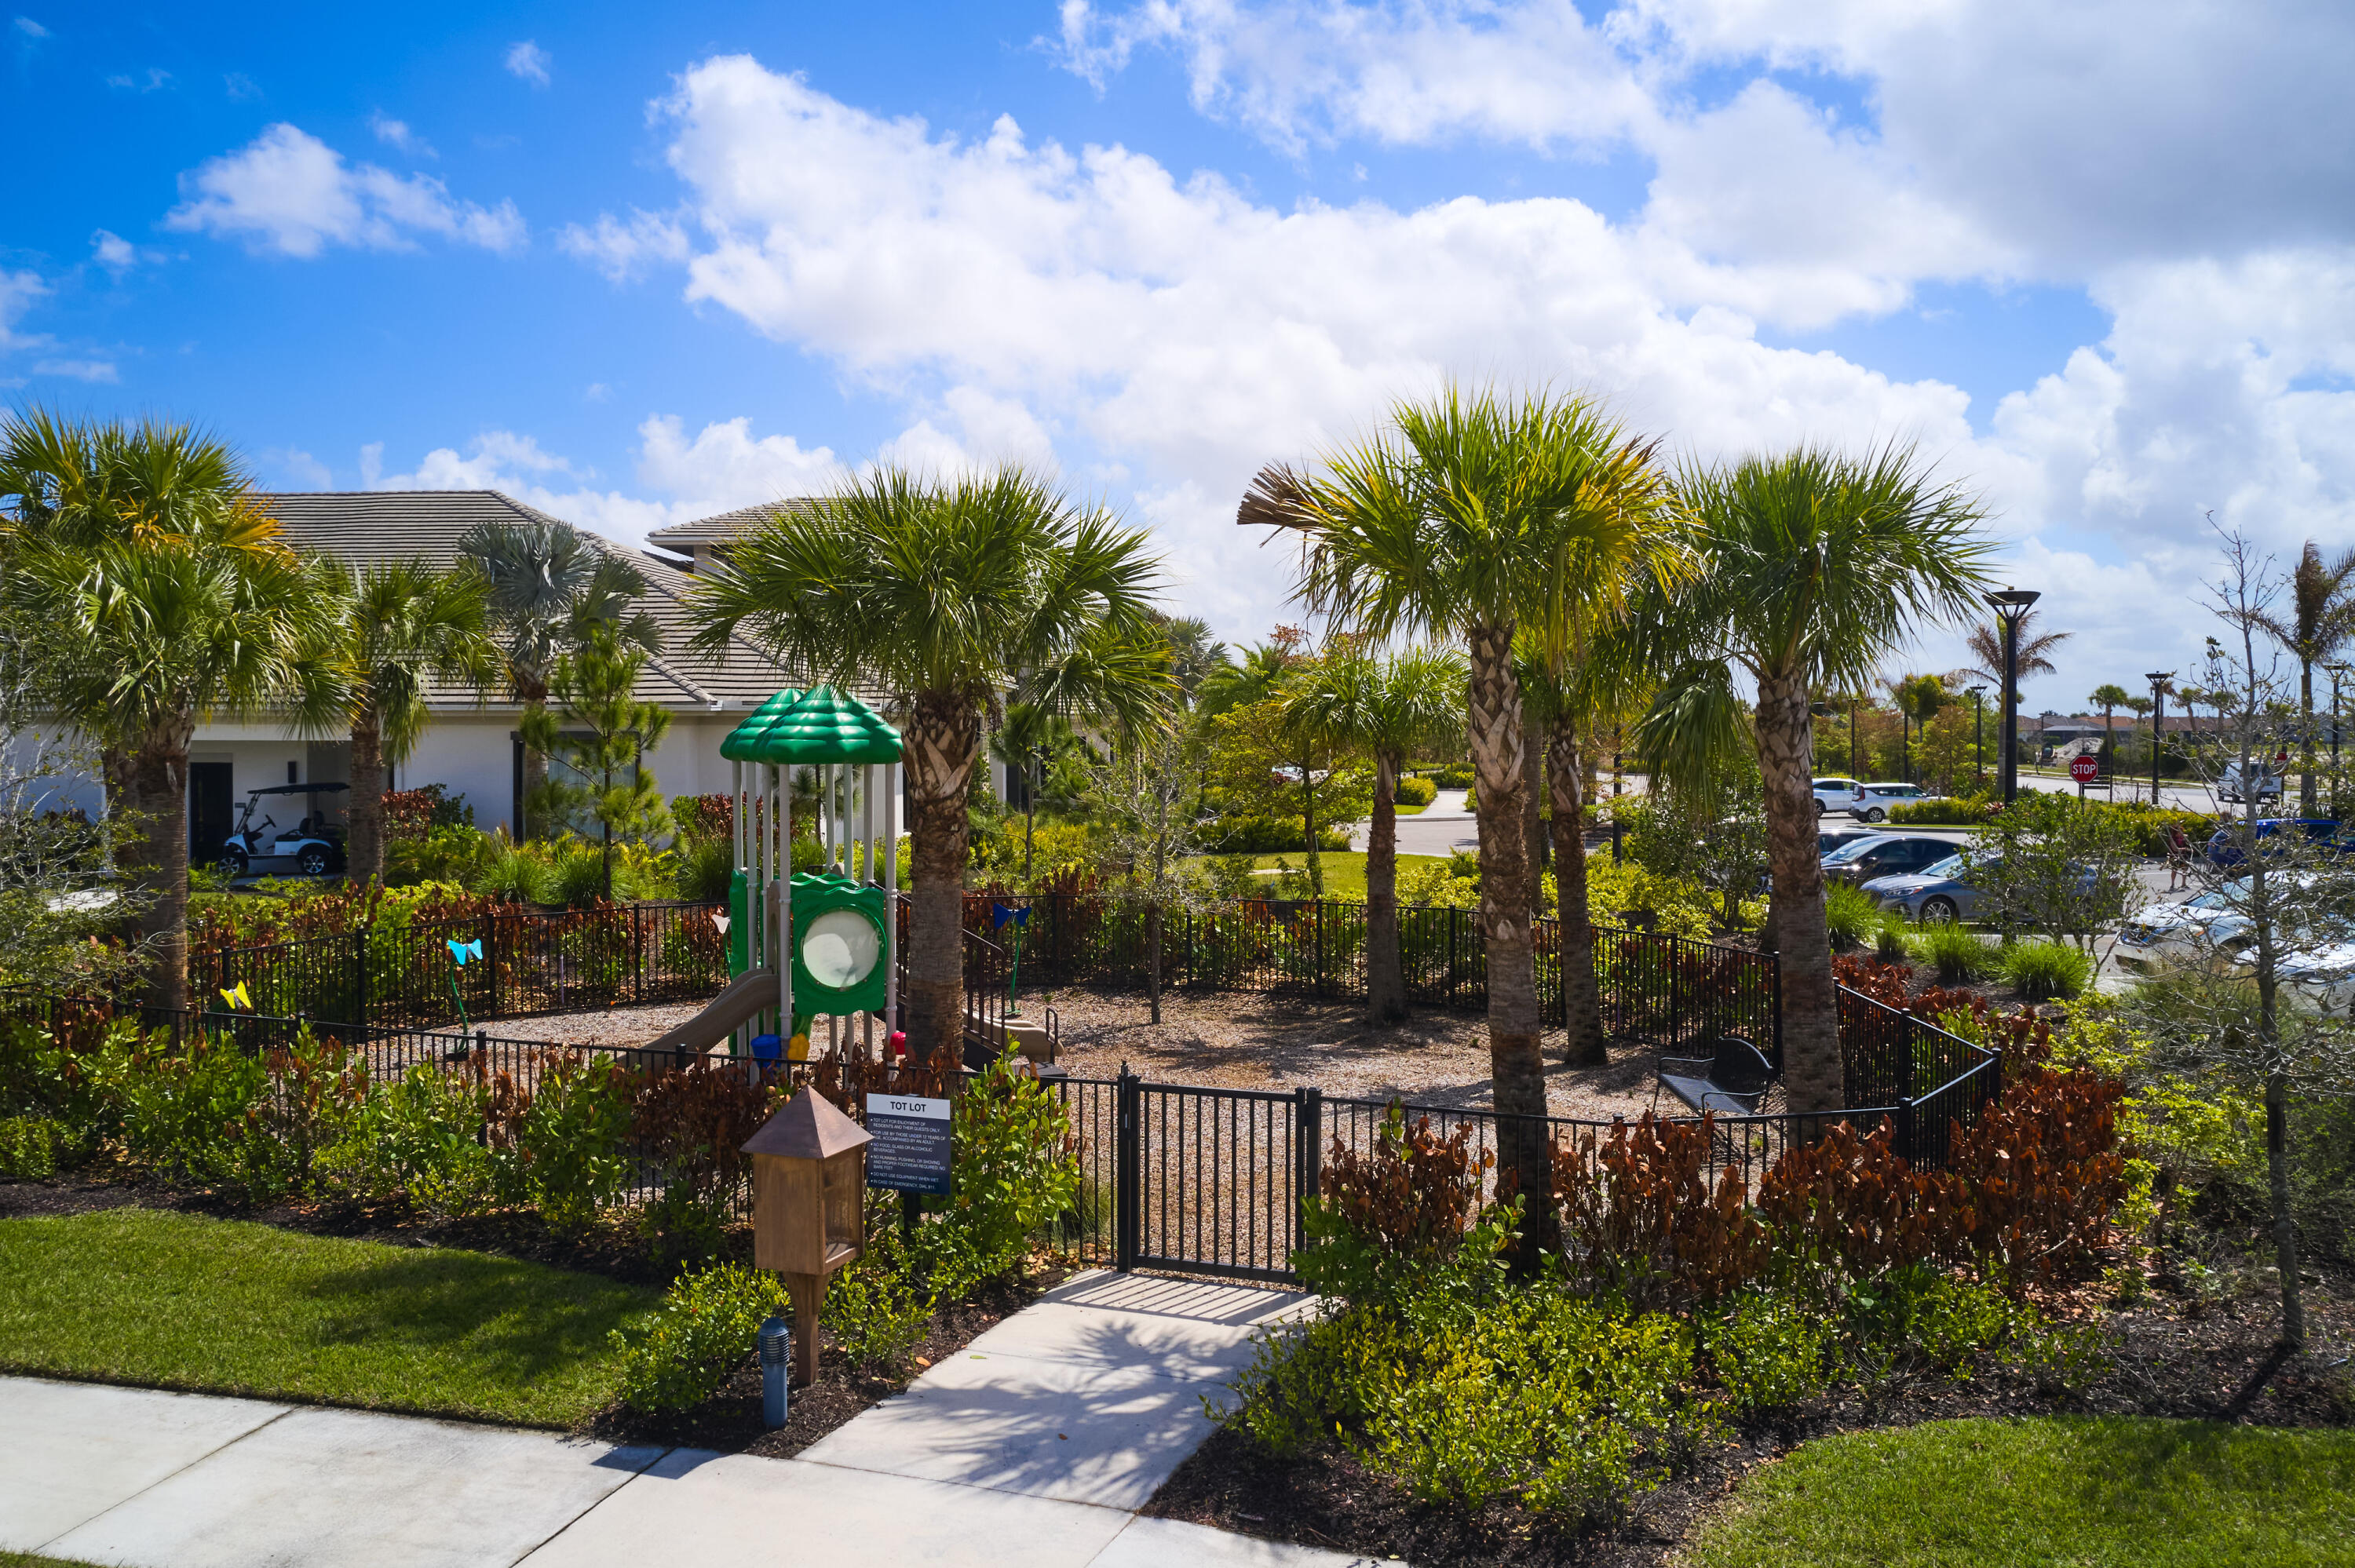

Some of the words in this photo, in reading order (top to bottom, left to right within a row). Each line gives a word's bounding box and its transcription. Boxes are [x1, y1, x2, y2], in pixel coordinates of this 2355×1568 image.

[2072, 764, 2096, 775] STOP
[890, 1101, 907, 1110] TOT
[909, 1103, 926, 1112] LOT
